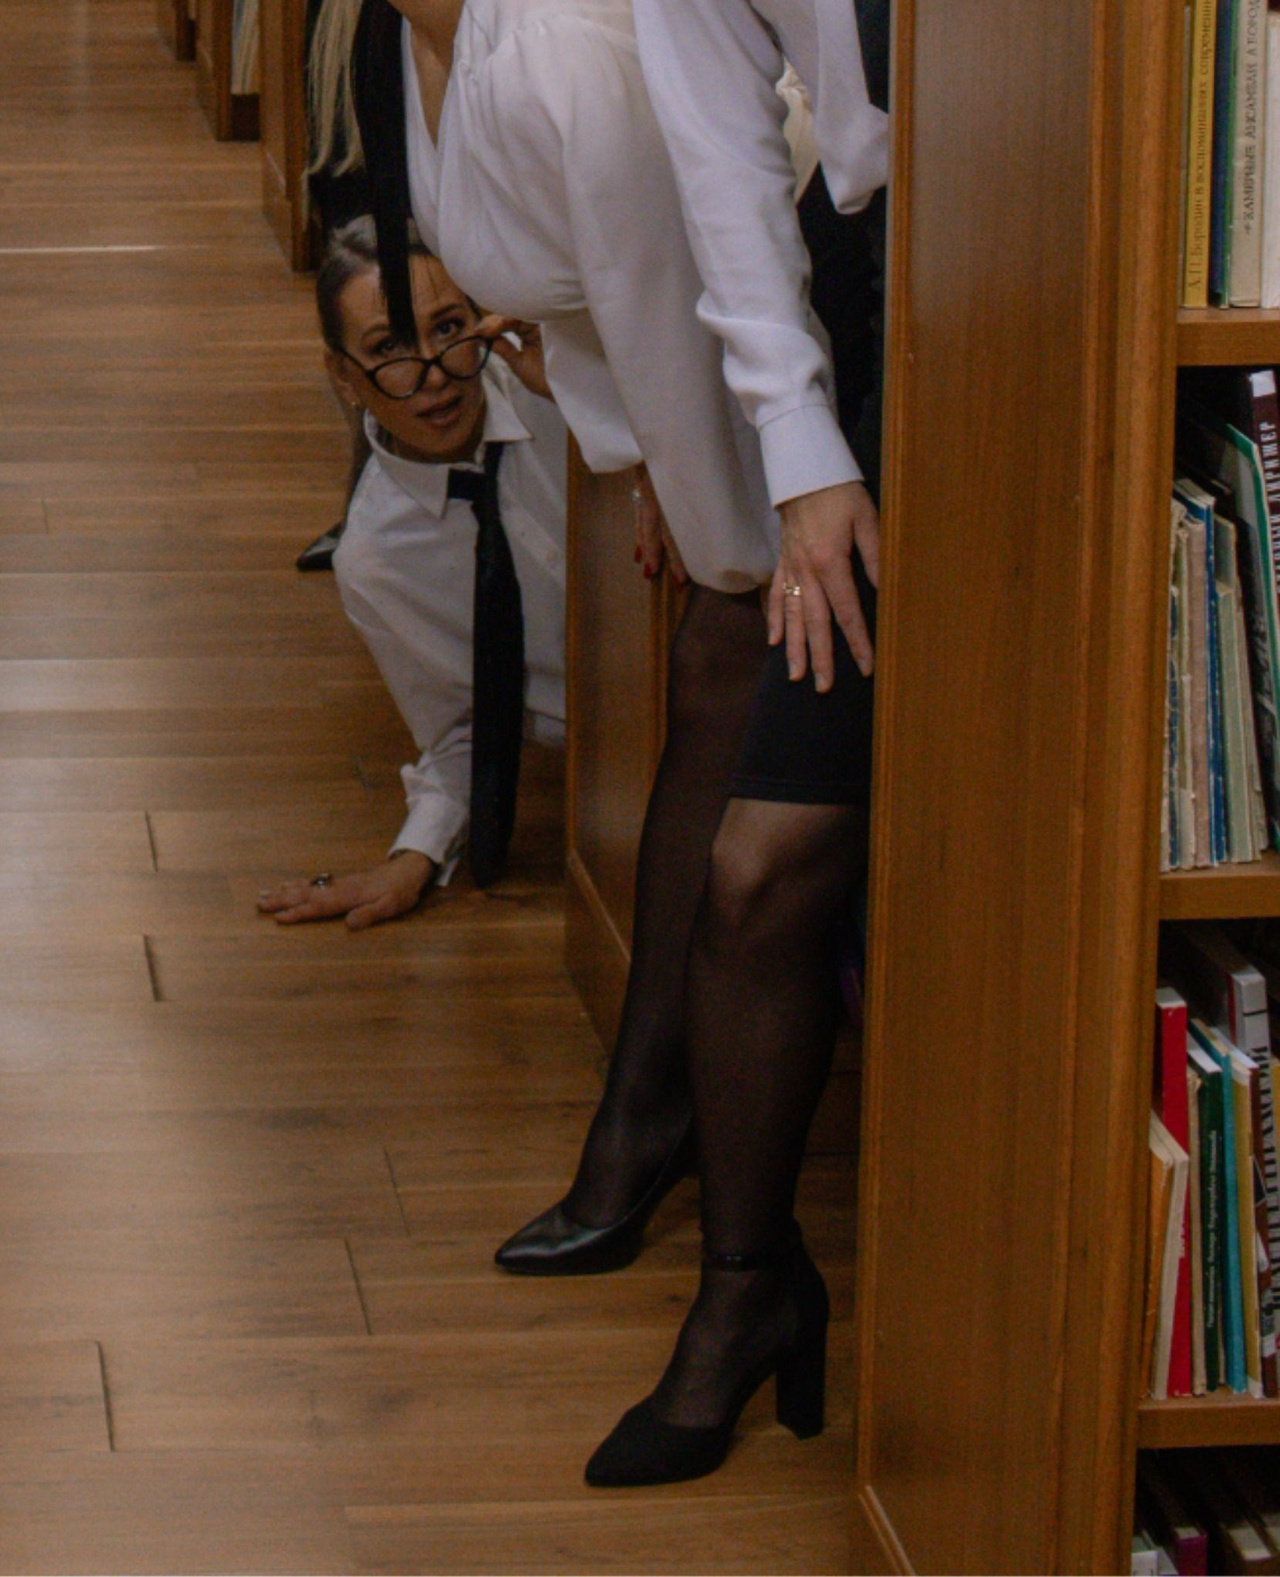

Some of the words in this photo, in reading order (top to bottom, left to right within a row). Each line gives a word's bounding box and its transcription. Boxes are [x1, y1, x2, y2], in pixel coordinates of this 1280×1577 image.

[1193, 81, 1209, 184] воспоминаниях
[1243, 63, 1258, 139] АНСАМБЛИ
[1241, 145, 1256, 220] КАМЕРНЫЕ
